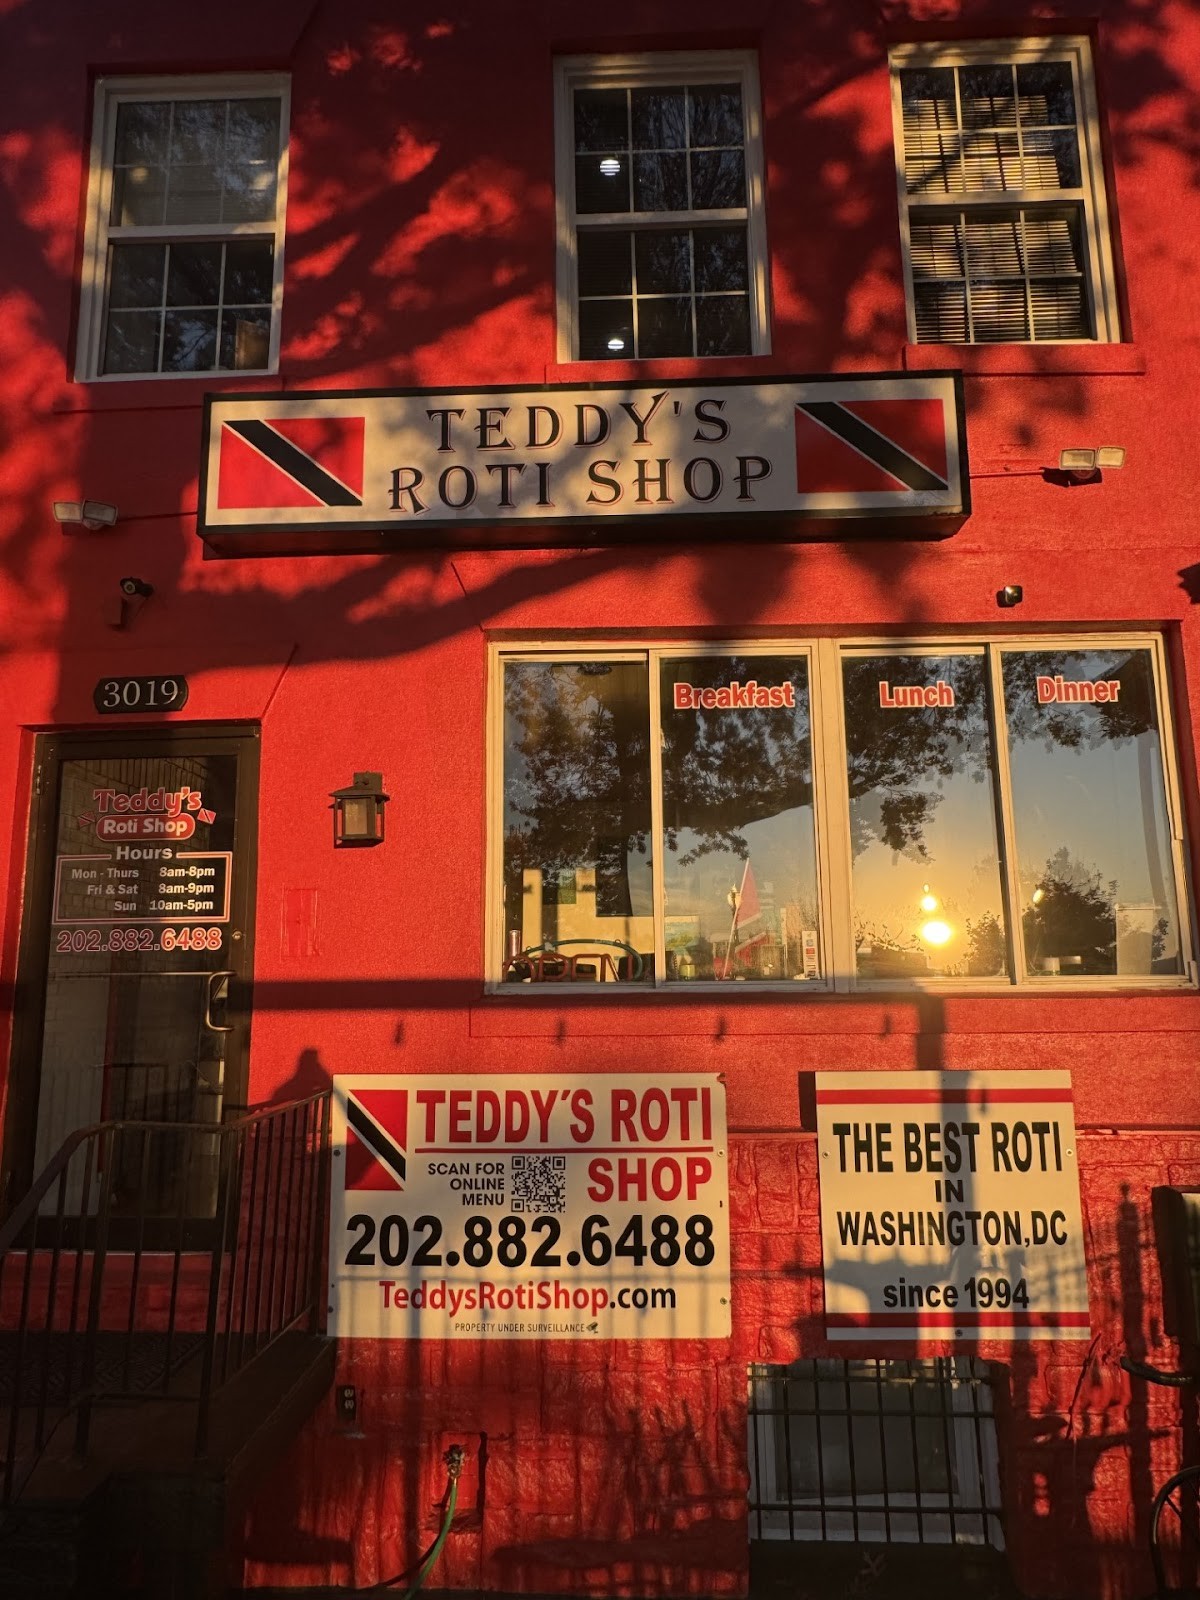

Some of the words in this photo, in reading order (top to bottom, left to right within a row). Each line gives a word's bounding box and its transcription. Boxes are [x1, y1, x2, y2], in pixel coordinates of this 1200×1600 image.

[426, 391, 730, 453] TEDDY'S
[388, 461, 555, 516] ROTI
[586, 456, 772, 506] SHOP
[103, 679, 179, 707] 3019
[674, 681, 795, 709] Breakfast
[878, 681, 954, 708] Lunch
[1036, 675, 1121, 703] Dinner
[93, 786, 202, 817] Teddy's
[103, 818, 138, 835] Roti
[142, 818, 188, 836] Shop
[116, 846, 173, 860] Hours
[71, 868, 97, 879] Mon
[107, 867, 139, 879] Thurs
[159, 866, 215, 879] 8am-8pm
[87, 884, 102, 896] Fri
[105, 884, 116, 895] &
[118, 883, 139, 895] Sat
[158, 882, 214, 895] 8am-9pm
[114, 901, 137, 911] Sun
[150, 899, 214, 912] 10am-5pm
[56, 927, 222, 952] 202.882.6488
[416, 1089, 594, 1144] TEDDY'S
[611, 1087, 712, 1142] ROTI
[833, 1123, 894, 1173] THE
[903, 1121, 980, 1173] BEST
[991, 1121, 1062, 1172] ROTI
[428, 1162, 471, 1176] SCAN
[475, 1162, 505, 1175] FOR
[587, 1156, 712, 1203] SHOP
[449, 1178, 505, 1192] ONLINE
[934, 1179, 964, 1203] IN
[461, 1193, 505, 1206] MENU
[345, 1214, 715, 1268] 202.882.6488
[836, 1210, 1068, 1248] WASHINGTON,DC
[379, 1280, 676, 1317] TeddysRotiShop.com
[883, 1278, 958, 1308] since
[964, 1277, 1029, 1309] 1994
[454, 1323, 495, 1332] PROPERTY
[498, 1323, 524, 1332] UNDER
[527, 1323, 585, 1333] SURVEILLANCE
